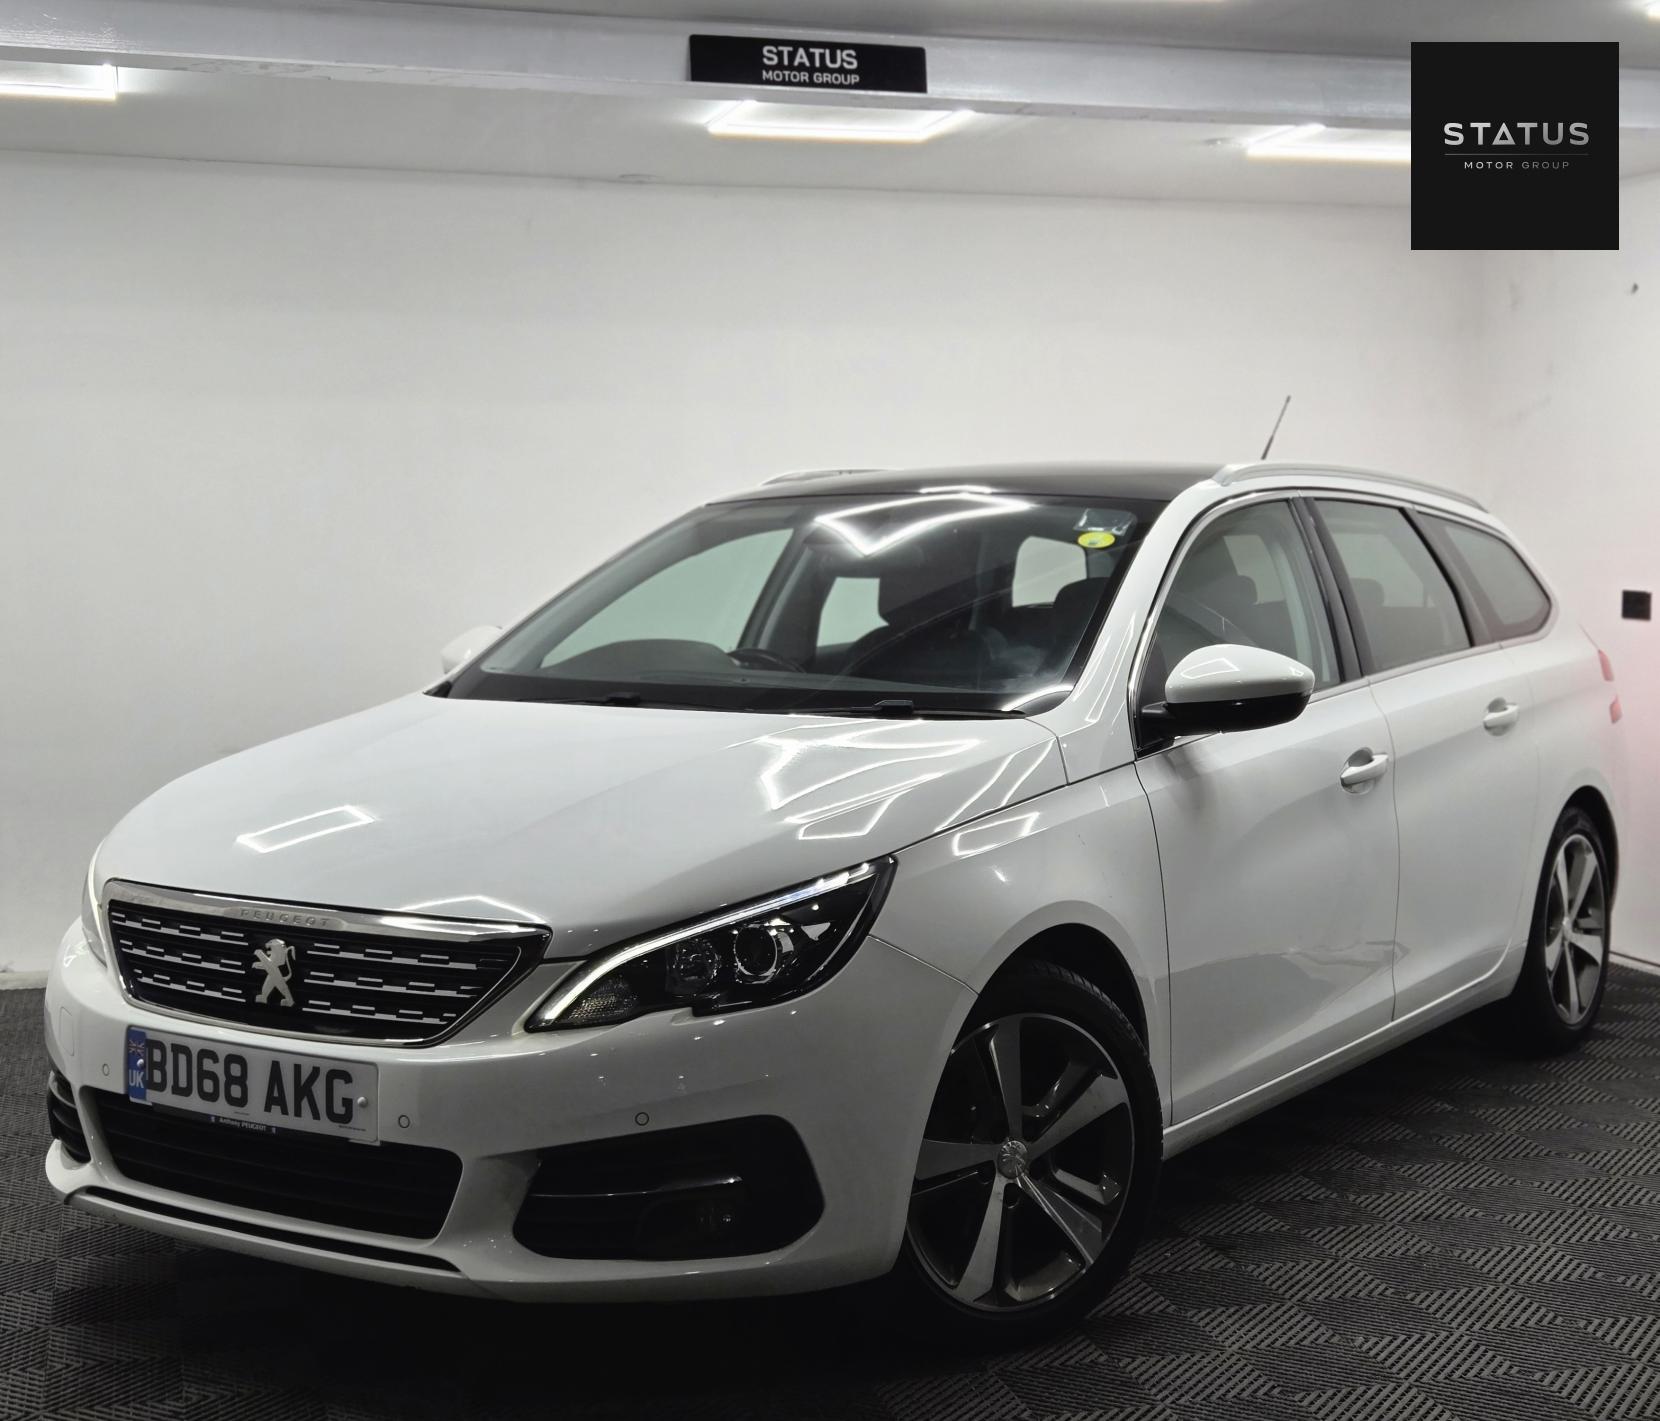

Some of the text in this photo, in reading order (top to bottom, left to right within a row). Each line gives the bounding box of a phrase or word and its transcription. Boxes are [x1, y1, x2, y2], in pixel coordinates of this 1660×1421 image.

[762, 45, 858, 69] STATUS
[762, 70, 860, 85] MOTOR GROUP
[240, 909, 329, 926] PEUGEOT
[128, 1070, 145, 1089] UK
[146, 1038, 353, 1124] BD68 AKG
